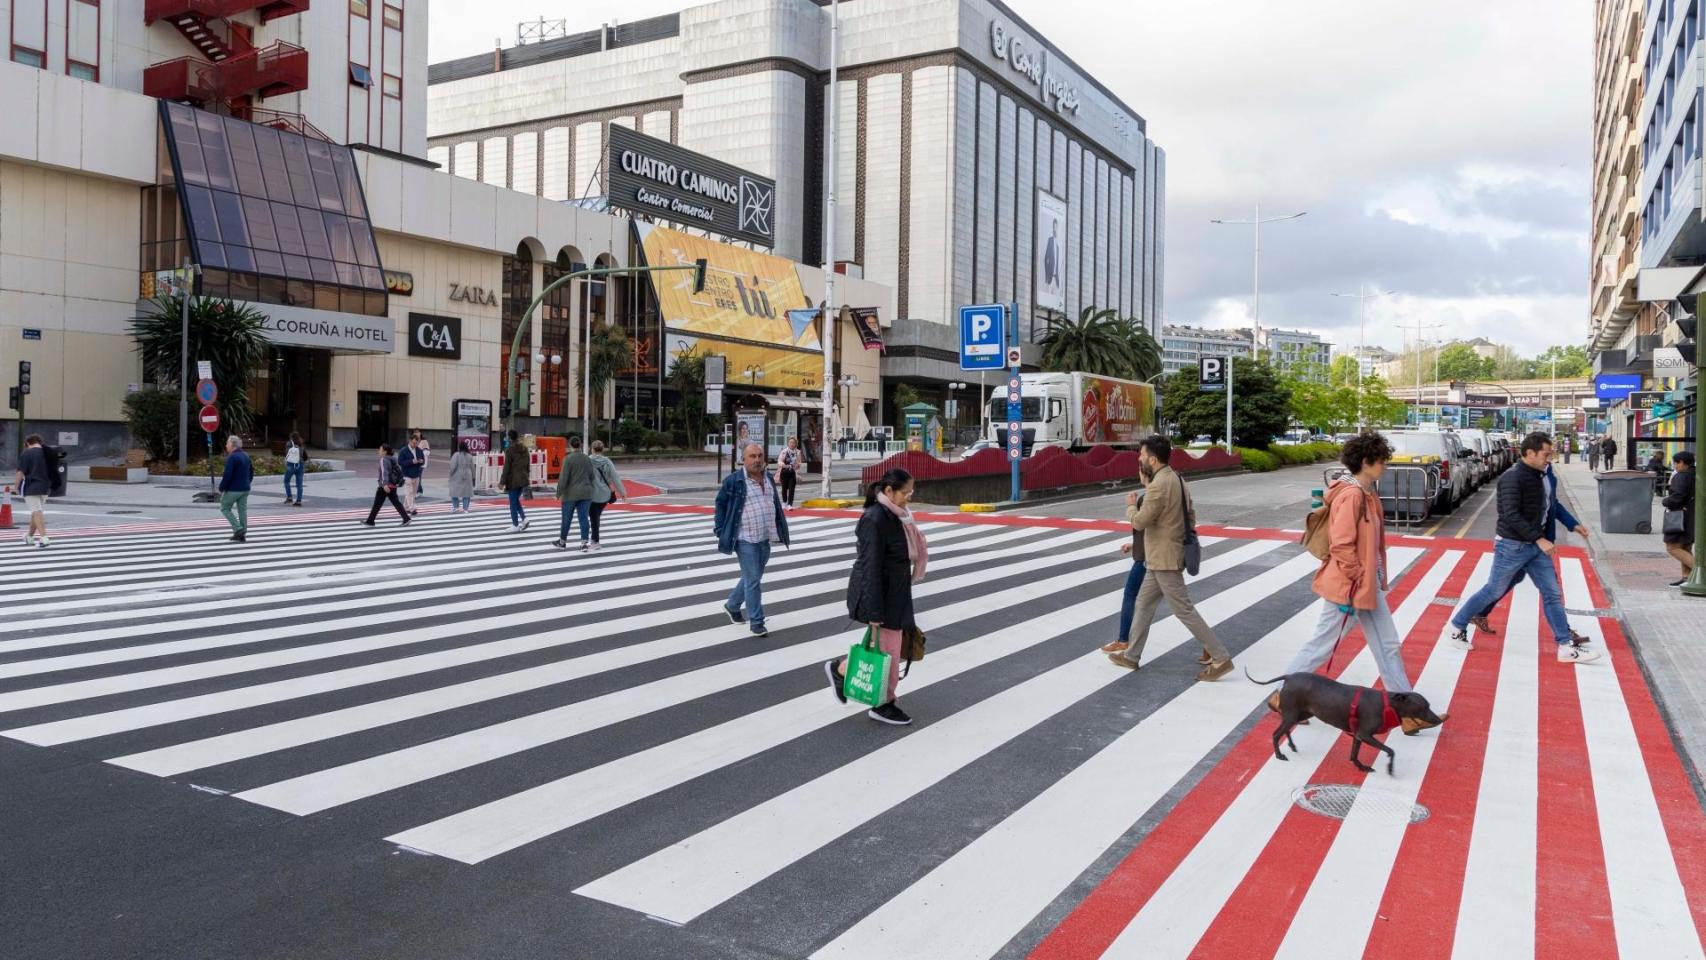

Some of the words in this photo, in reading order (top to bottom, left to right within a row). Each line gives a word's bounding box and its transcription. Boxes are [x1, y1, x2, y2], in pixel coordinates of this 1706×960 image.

[991, 19, 1008, 60] El
[1009, 37, 1041, 85] Corte
[1041, 50, 1080, 115] Inglés
[621, 150, 678, 186] CUATRO
[680, 169, 739, 204] CAMINOS
[636, 187, 670, 208] Centro
[671, 198, 714, 221] Comercial
[385, 274, 412, 293] DIS
[449, 283, 498, 307] ZARA
[704, 285, 734, 300] ENTRO
[715, 297, 738, 311] ERES
[276, 319, 340, 337] CORUÑA
[344, 326, 388, 341] HOTEL
[417, 322, 455, 351] C&A
